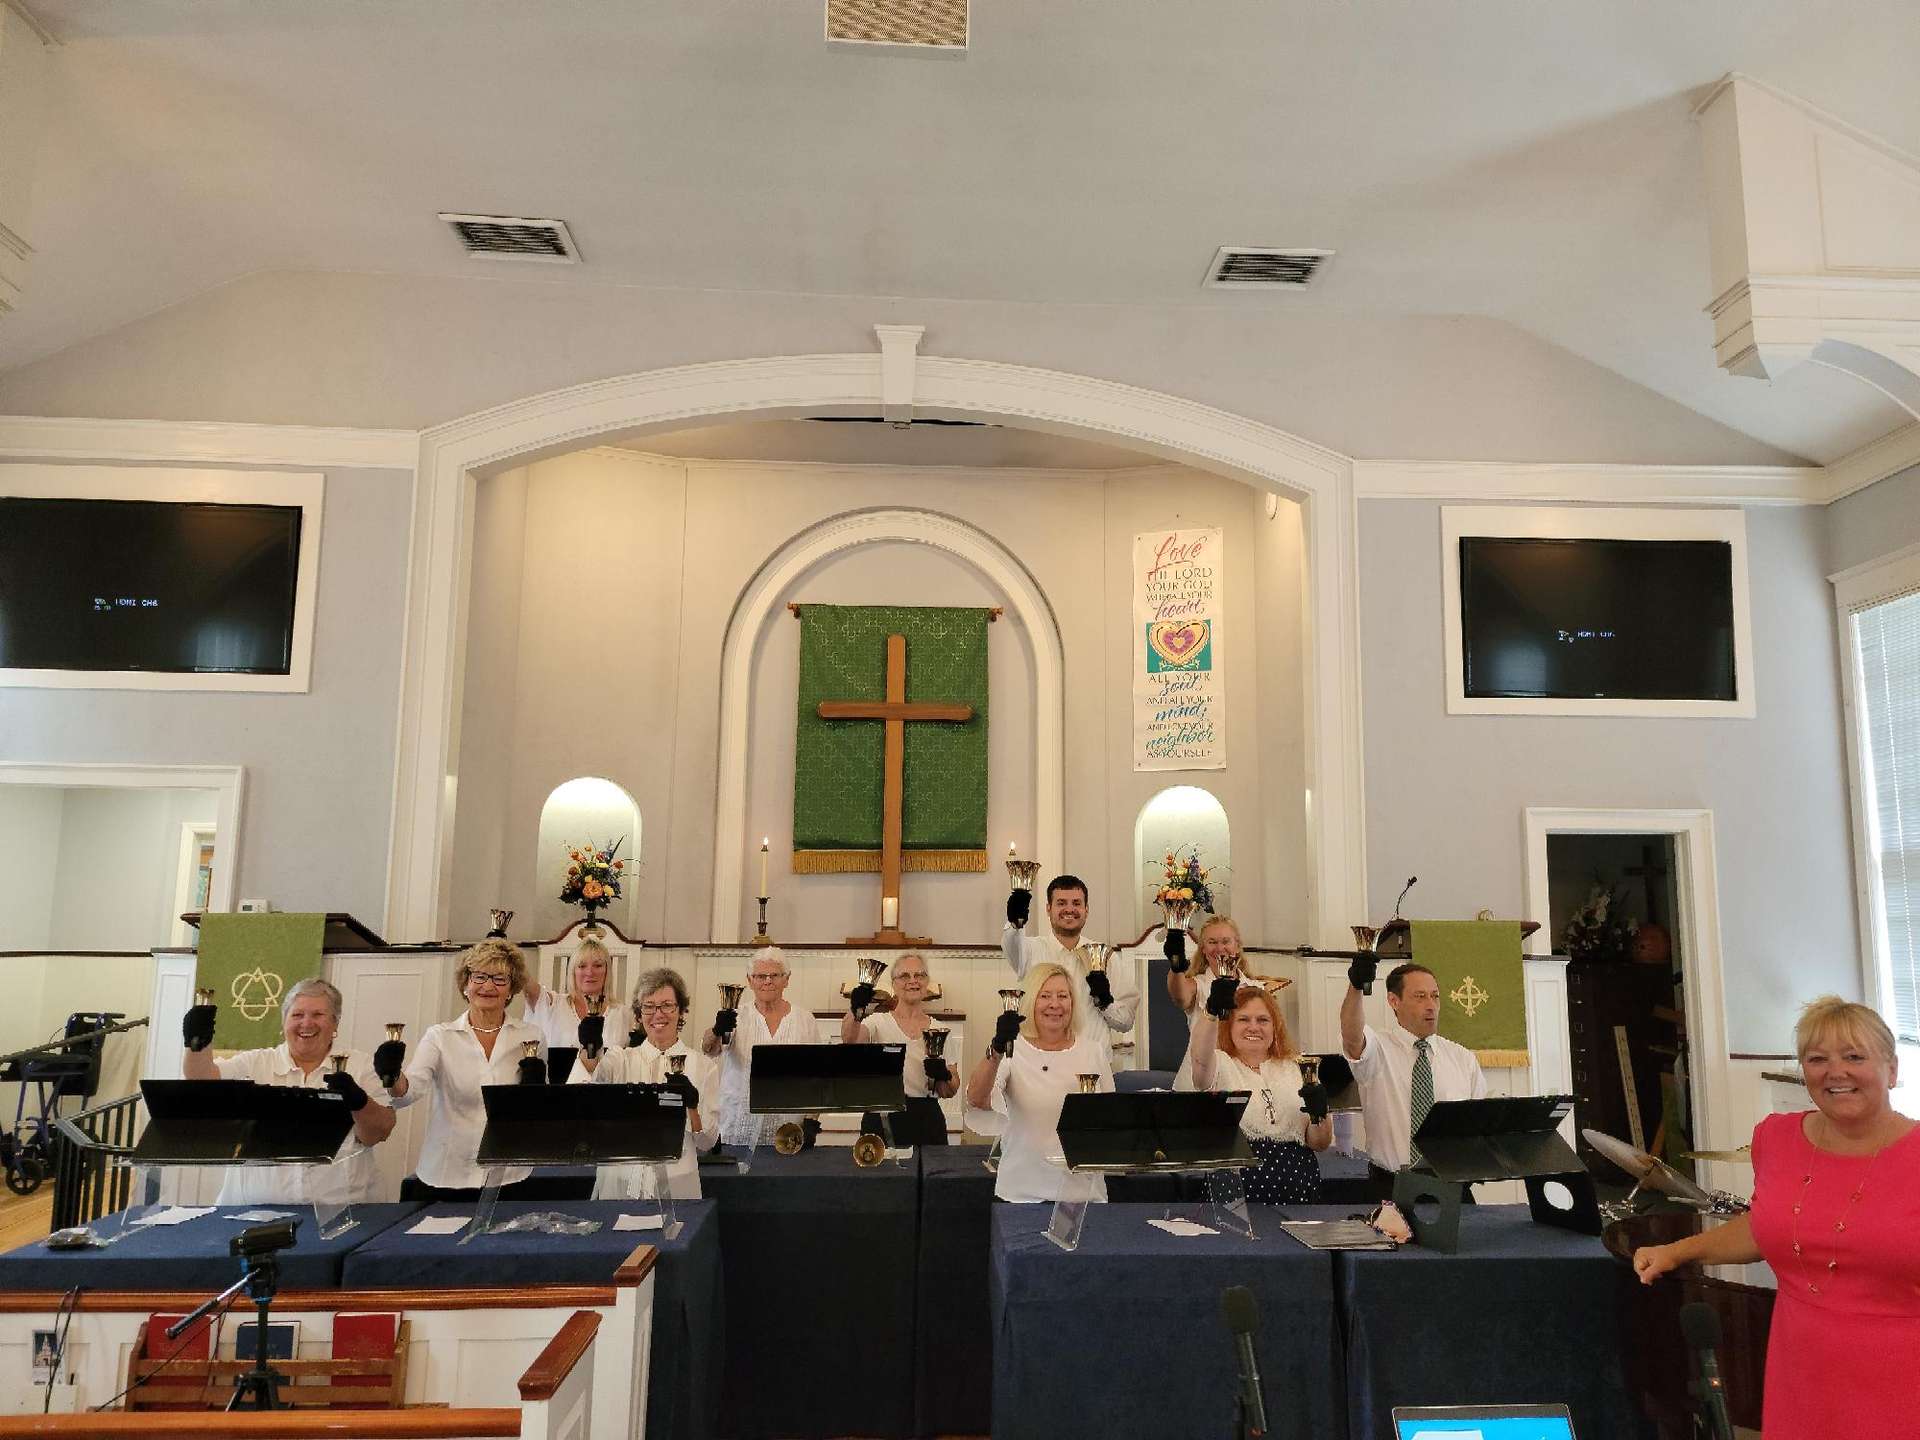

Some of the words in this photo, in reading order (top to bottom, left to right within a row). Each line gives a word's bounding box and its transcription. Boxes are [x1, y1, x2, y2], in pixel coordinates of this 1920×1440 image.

[1175, 567, 1213, 580] LORD
[1146, 582, 1179, 592] YOUR
[1183, 580, 1213, 590] GOD
[1148, 674, 1170, 683] ALL
[1176, 672, 1211, 682] YOUR
